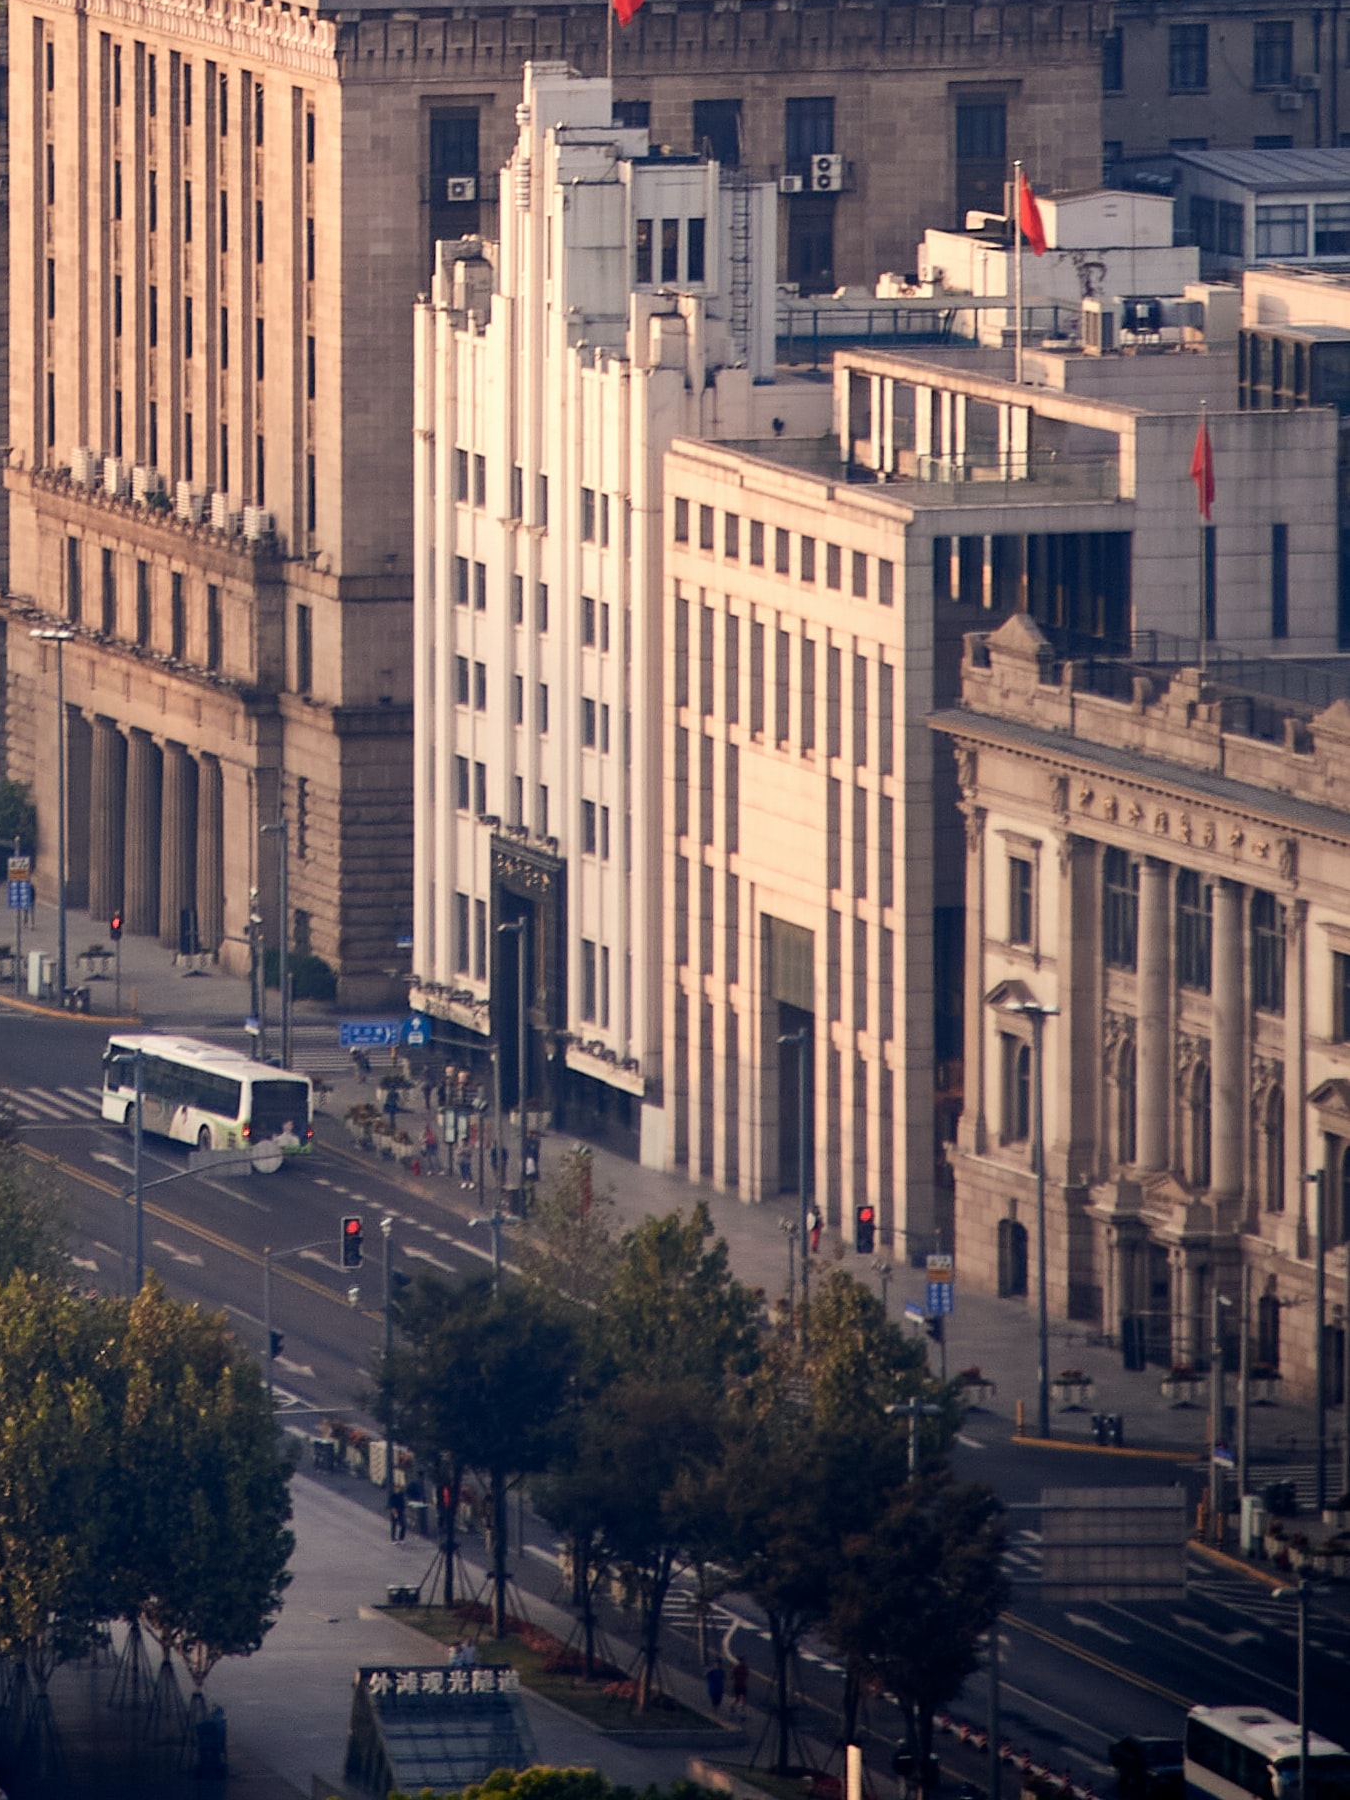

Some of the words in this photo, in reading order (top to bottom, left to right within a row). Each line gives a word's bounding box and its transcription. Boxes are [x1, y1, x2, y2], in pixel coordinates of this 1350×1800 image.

[369, 1669, 520, 1696] 外滩观光隧道
